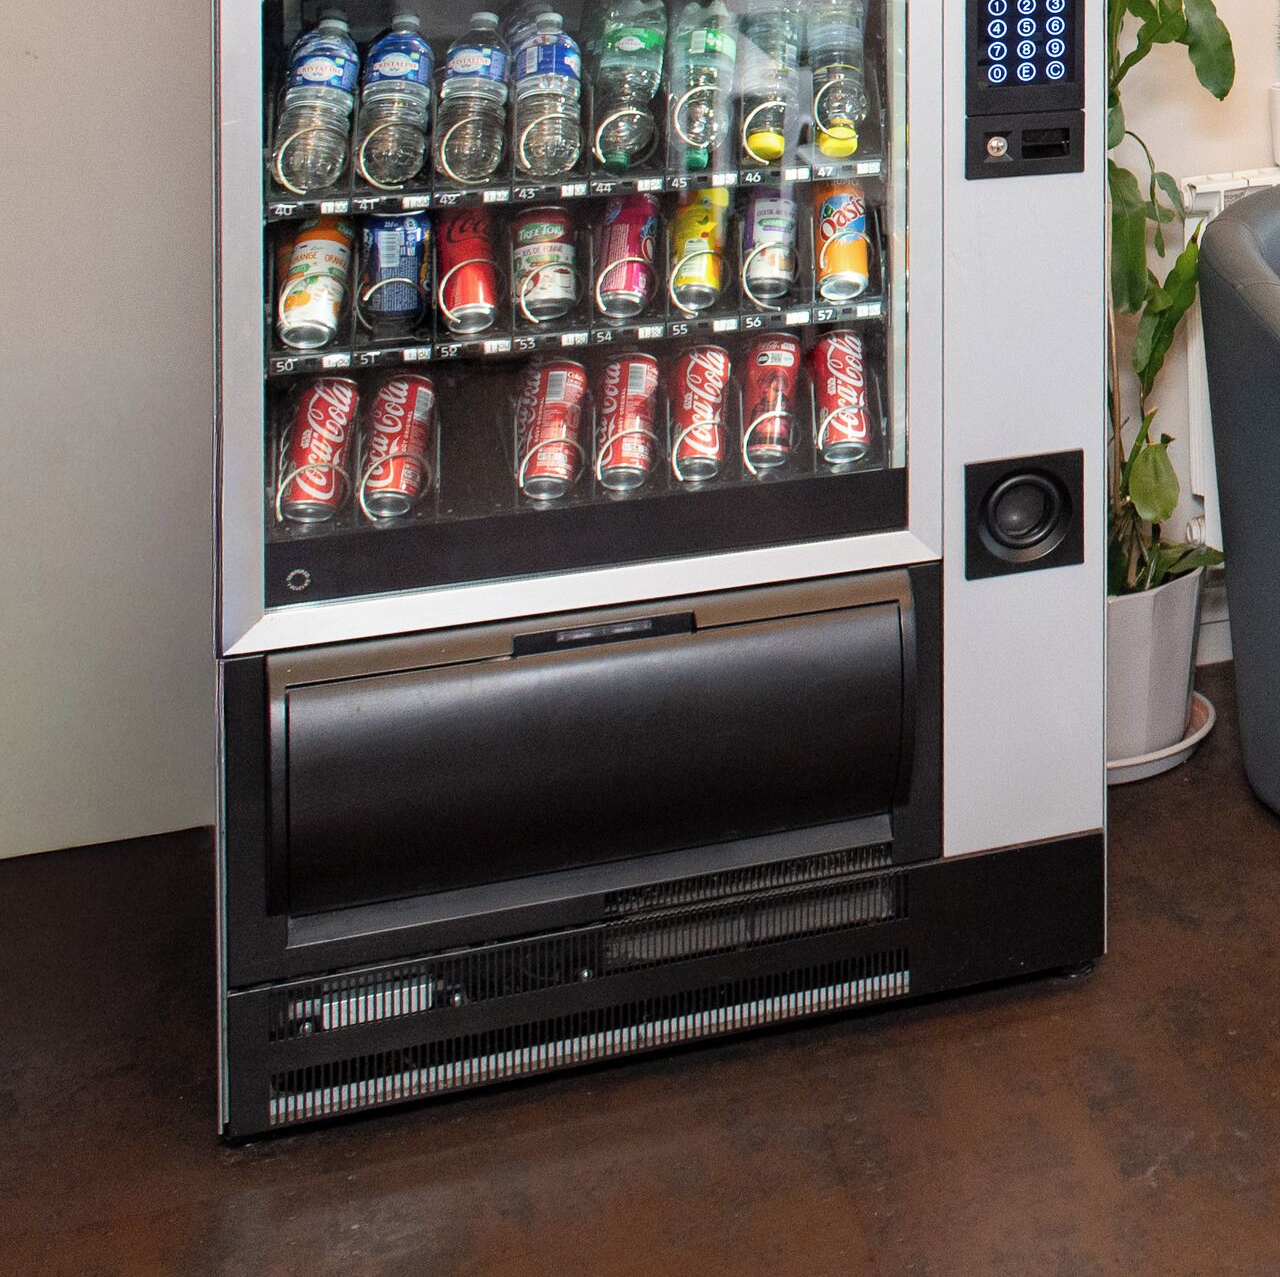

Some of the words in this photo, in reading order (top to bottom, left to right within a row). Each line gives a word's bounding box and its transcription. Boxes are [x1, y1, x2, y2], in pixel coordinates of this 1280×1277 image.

[994, 1, 1000, 11] 1
[1022, 0, 1030, 10] 2
[1052, 0, 1060, 9] 3
[992, 24, 1001, 34] 4
[1022, 22, 1030, 33] 5
[1051, 21, 1060, 31] 6
[993, 46, 1001, 57] 7
[1022, 44, 1030, 55] 8
[1051, 43, 1060, 53] 9
[993, 68, 1001, 79] 0
[1022, 66, 1030, 77] E
[1051, 65, 1060, 75] C
[745, 172, 761, 183] 46
[817, 166, 833, 177] 47
[596, 183, 612, 193] 44
[671, 177, 687, 188] 45
[439, 194, 456, 205] 42
[519, 188, 536, 199] 43
[519, 229, 540, 241] TREE
[817, 310, 833, 321] 57
[745, 317, 762, 328] 56
[672, 324, 689, 336] 55
[596, 332, 612, 343] 54
[520, 338, 536, 350] 53
[441, 346, 458, 358] 52
[360, 353, 375, 365] 51
[276, 360, 294, 372] 50
[827, 331, 864, 444] Coca-Cola
[682, 347, 727, 458] Coca-Cola
